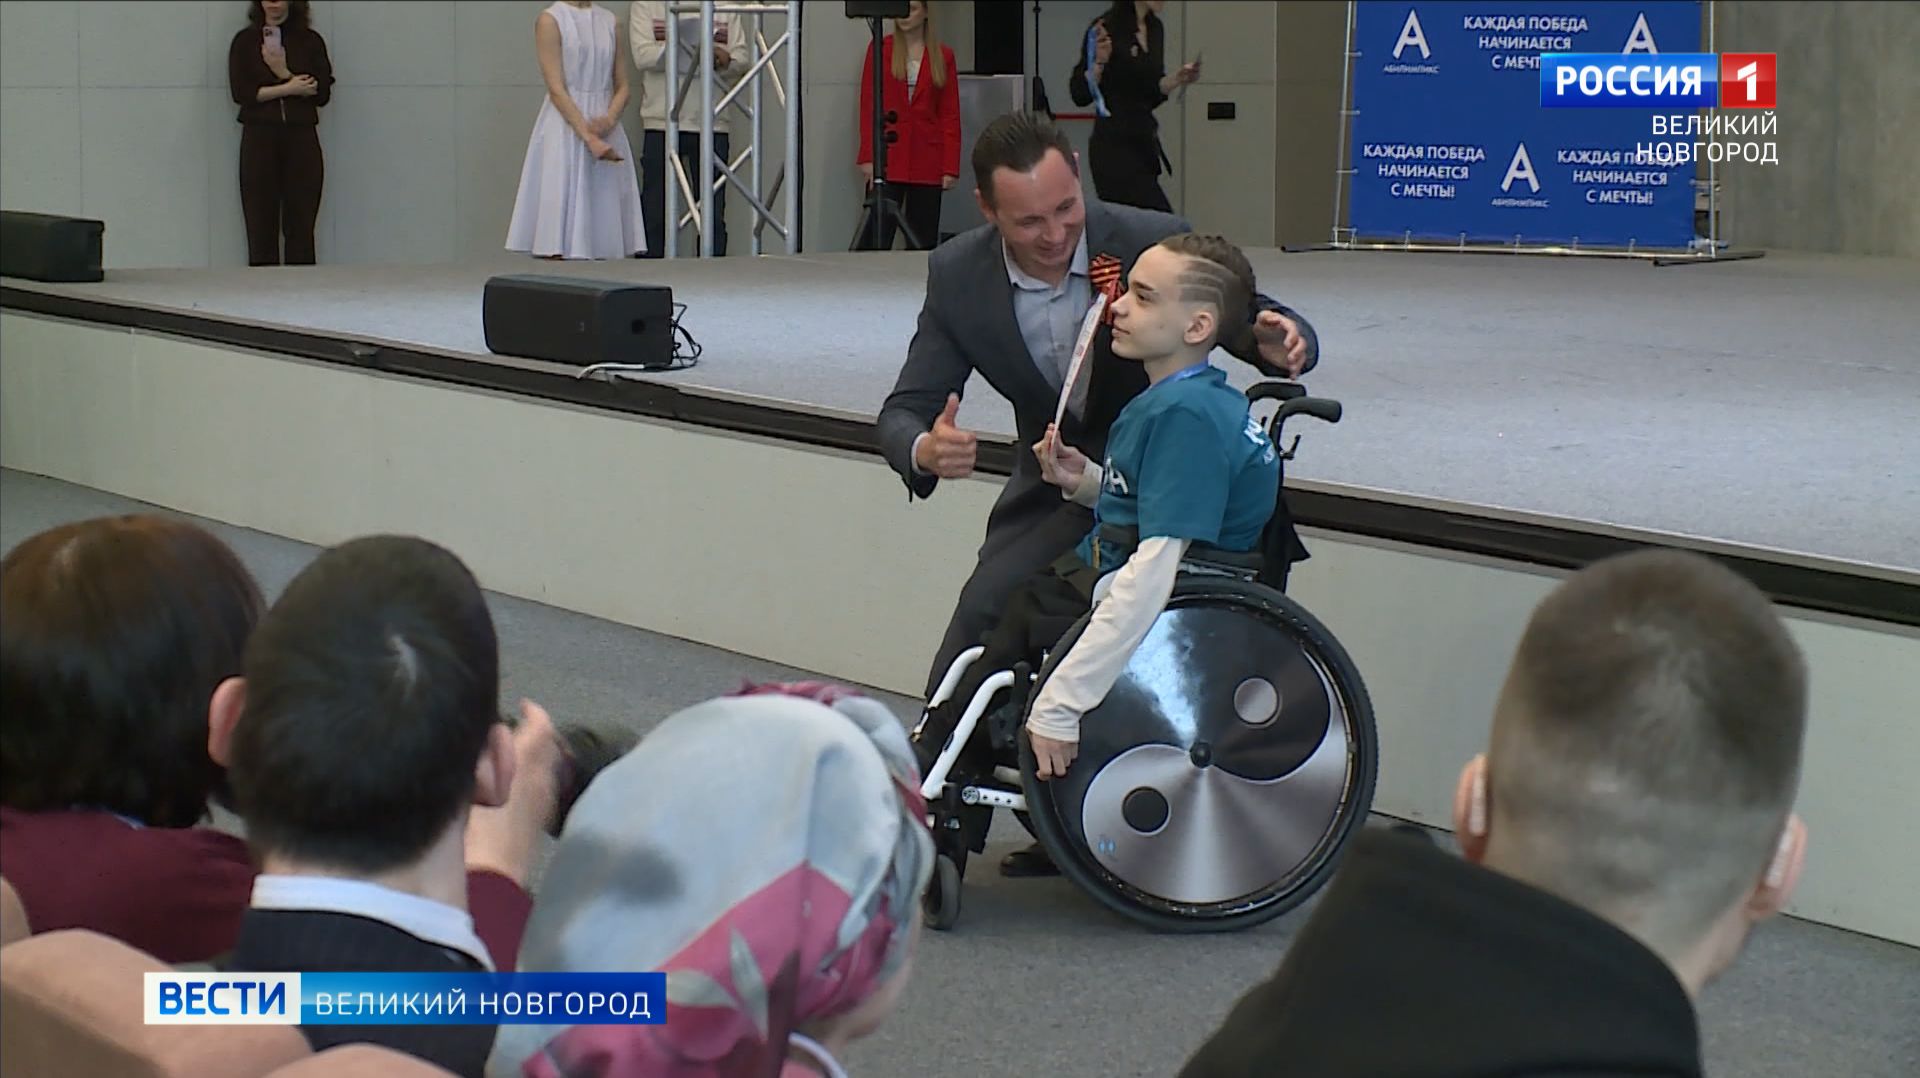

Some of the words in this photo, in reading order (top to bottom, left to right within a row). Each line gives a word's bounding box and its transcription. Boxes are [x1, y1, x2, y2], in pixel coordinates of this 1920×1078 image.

[1464, 16, 1525, 31] КАЖДАЯ
[1529, 17, 1588, 32] ПОБЕДА
[1479, 36, 1571, 49] НАЧИНАЕТСЯ
[1492, 55, 1502, 69] С
[1504, 56, 1540, 69] МЕЧТ
[1363, 144, 1424, 160] КАЖДАЯ
[1427, 146, 1485, 162] ПОБЕДА
[1557, 150, 1620, 165] КАЖДАЯ
[1378, 164, 1469, 179] НАЧИНАЕТСЯ
[1573, 170, 1667, 185] НАЧИНАЕТСЯ
[1391, 183, 1401, 196] С
[1403, 184, 1455, 198] МЕЧТЫ!
[1586, 190, 1596, 203] С
[1599, 190, 1653, 205] МЕЧТЫ!
